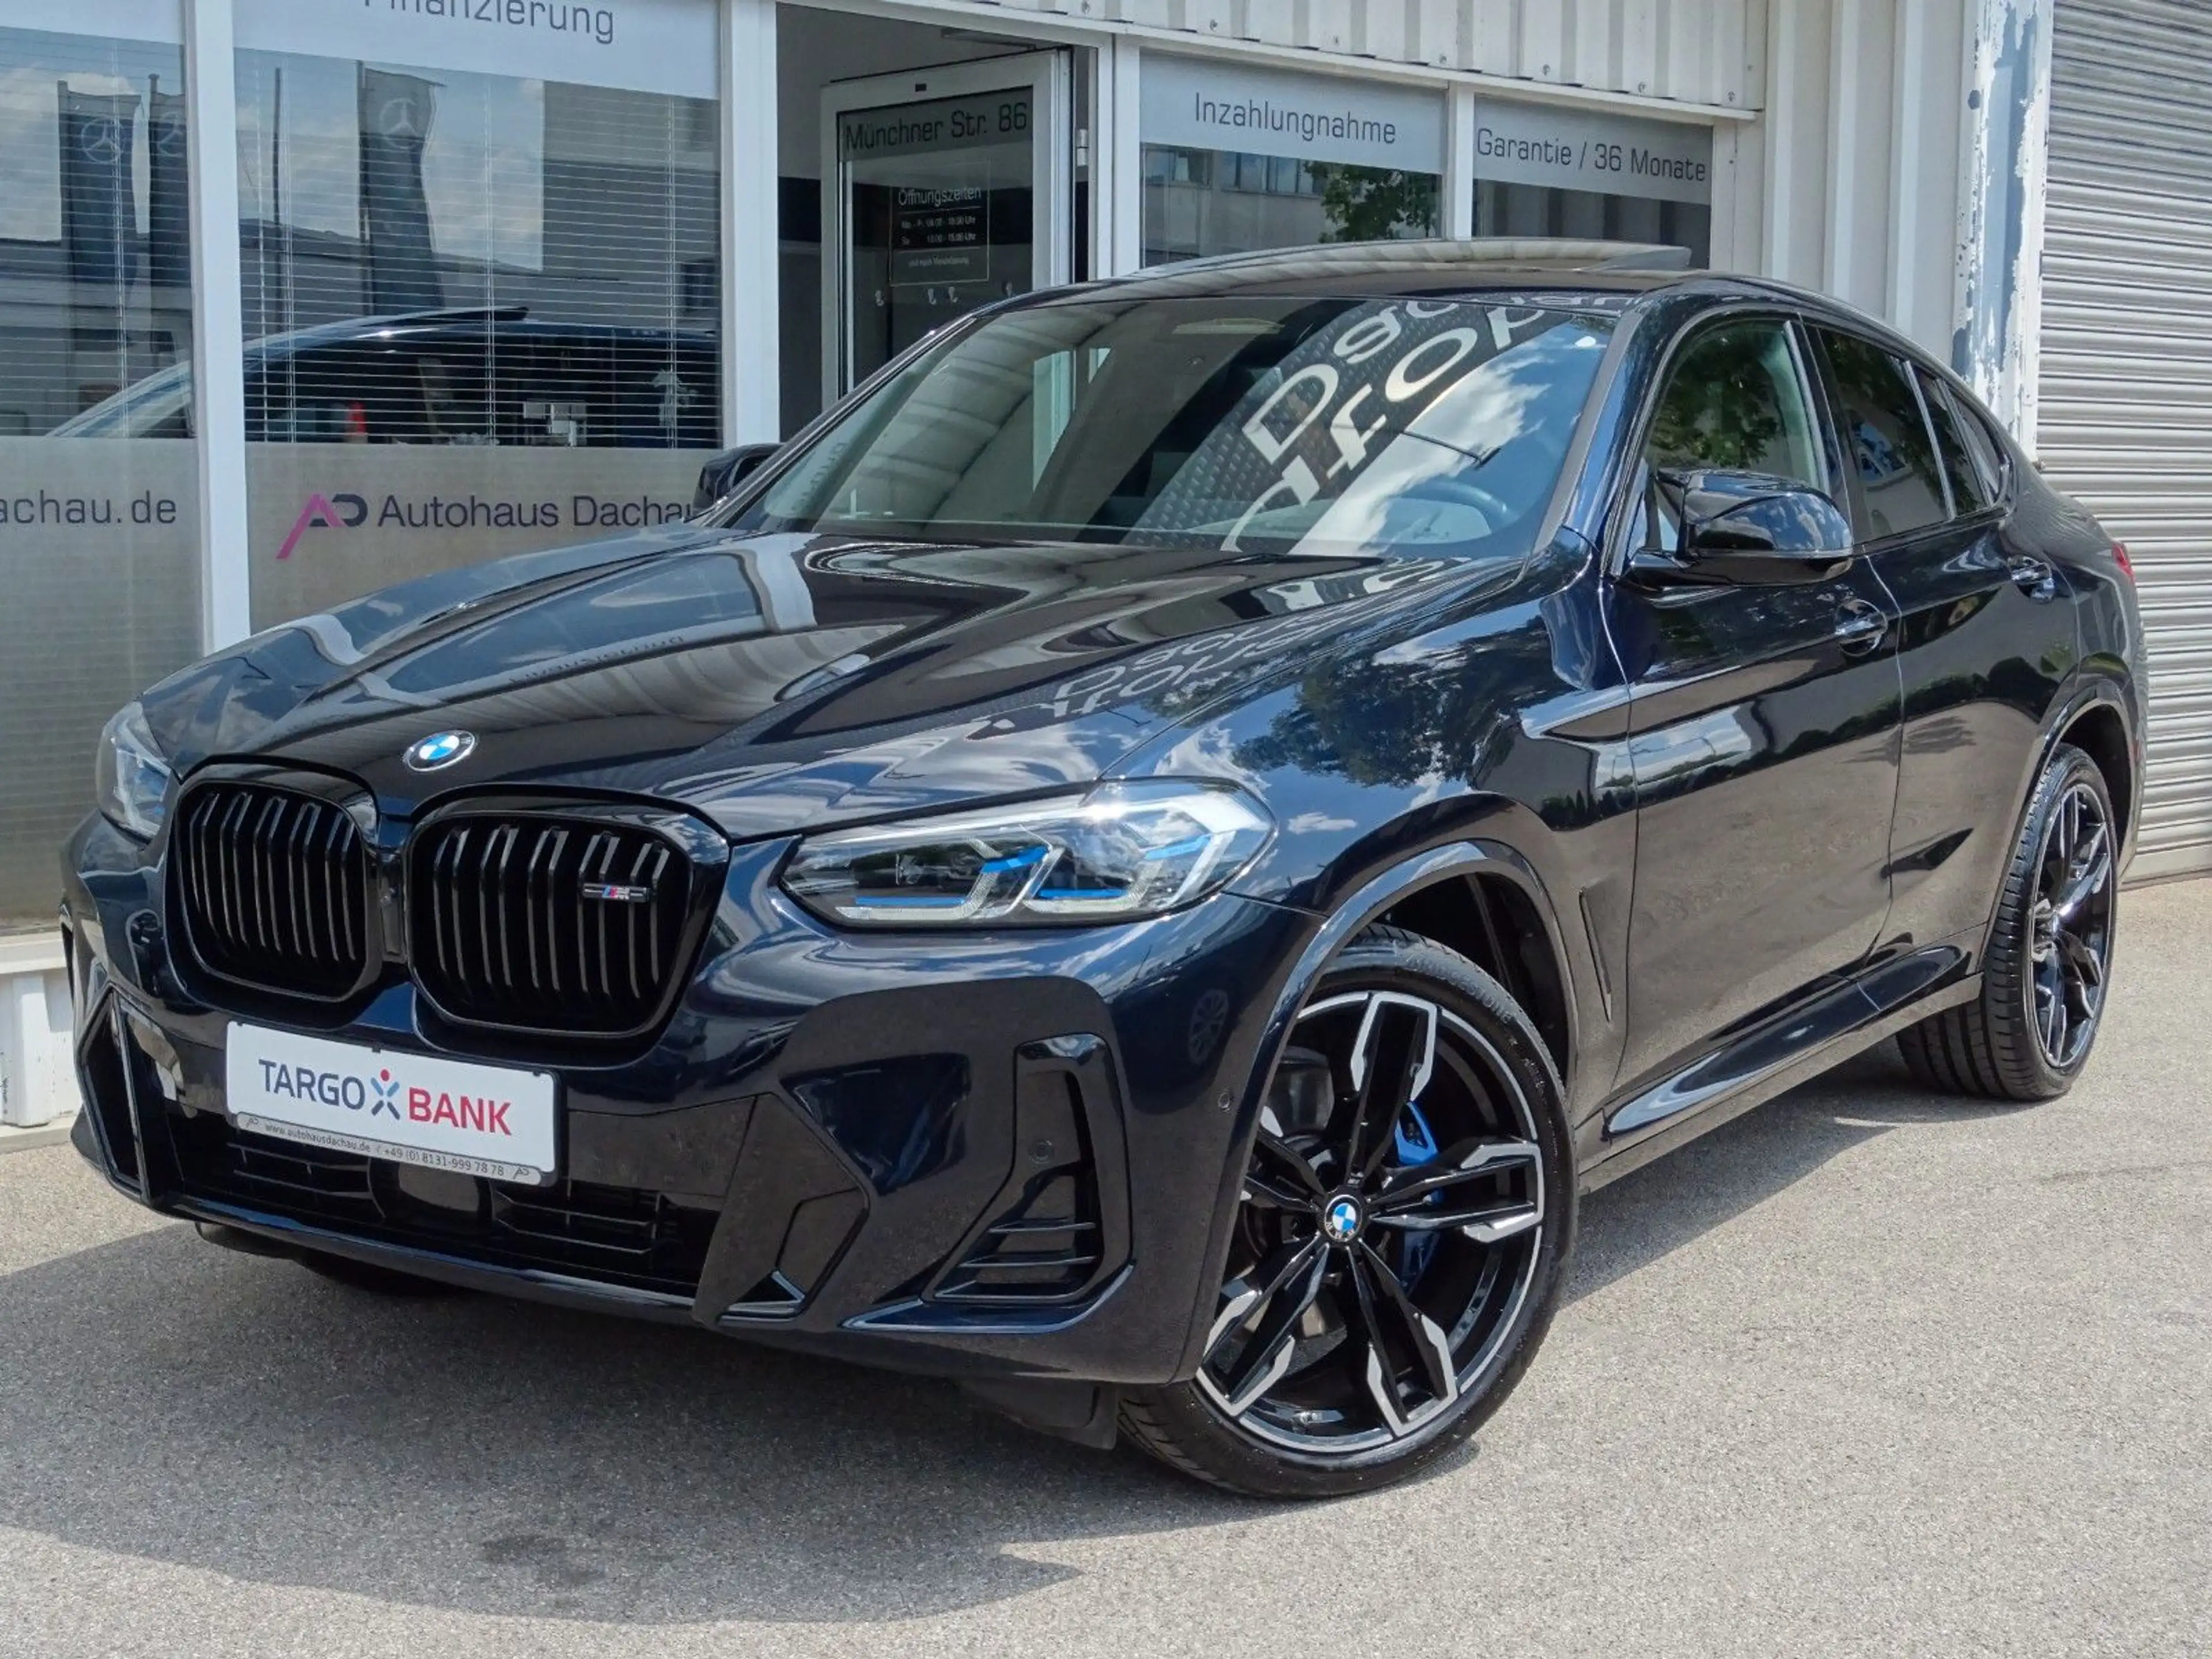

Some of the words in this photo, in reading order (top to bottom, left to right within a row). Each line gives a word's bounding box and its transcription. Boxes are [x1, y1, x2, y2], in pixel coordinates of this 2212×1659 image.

[365, 0, 613, 44] anzierung
[845, 118, 944, 151] Münchner
[951, 109, 987, 138] Str.
[998, 102, 1027, 132] 86
[1195, 92, 1396, 144] Inzahlungnahme
[1477, 128, 1571, 165] Garantie
[1578, 142, 1587, 170] /
[1594, 143, 1622, 171] 36
[1631, 148, 1706, 181] Monate
[899, 187, 982, 207] Öffnungszeiten
[378, 495, 559, 527] Autohaus
[258, 1058, 365, 1111] TARGO
[408, 1086, 512, 1137] BANK
[422, 1154, 471, 1171] 8131-999
[474, 1161, 488, 1173] 78
[492, 1165, 505, 1176] 78
